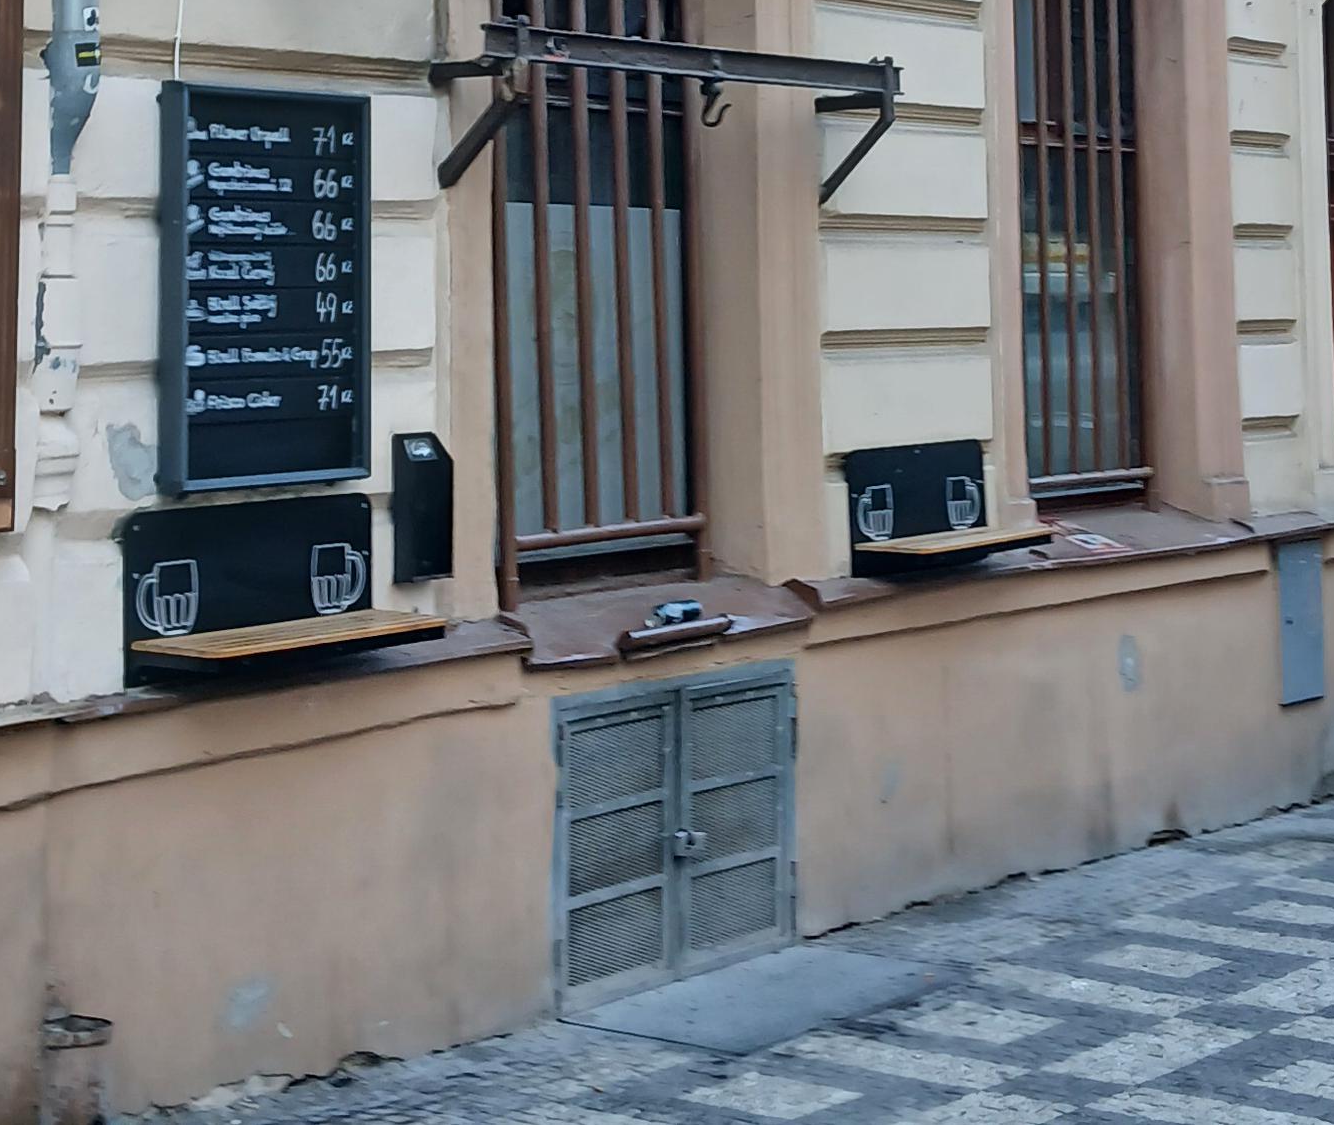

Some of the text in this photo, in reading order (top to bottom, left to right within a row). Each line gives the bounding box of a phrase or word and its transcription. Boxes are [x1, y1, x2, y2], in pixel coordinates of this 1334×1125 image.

[312, 125, 336, 155] 71
[313, 168, 339, 199] 66
[312, 209, 338, 241] 66
[315, 252, 337, 283] 66
[316, 291, 338, 323] 49
[319, 338, 344, 368] 55
[317, 384, 339, 411] 71
